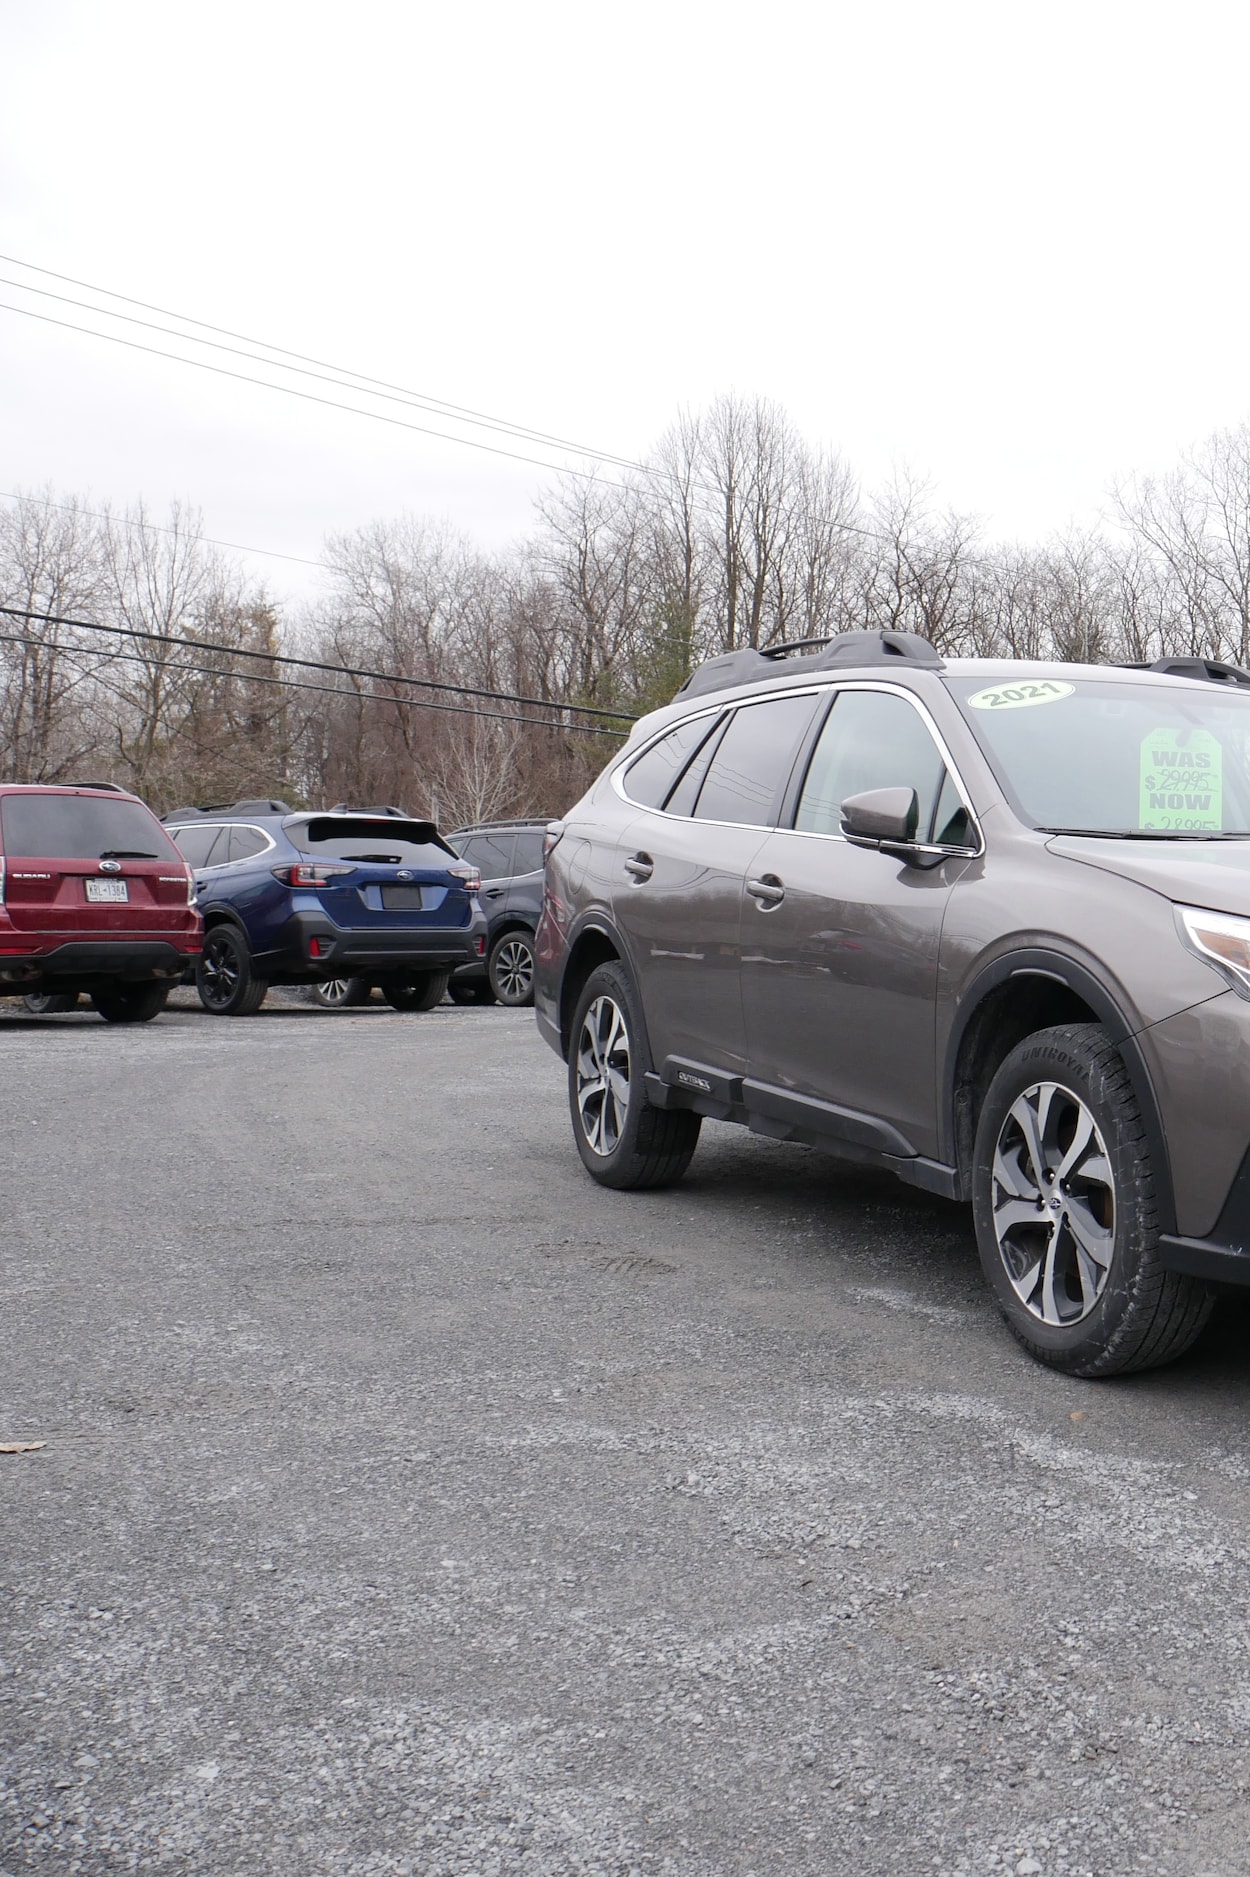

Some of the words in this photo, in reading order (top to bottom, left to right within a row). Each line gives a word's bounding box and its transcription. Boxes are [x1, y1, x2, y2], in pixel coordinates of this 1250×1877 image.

[982, 682, 1061, 707] 2021
[1151, 750, 1211, 768] WAS
[1149, 793, 1212, 811] NOW
